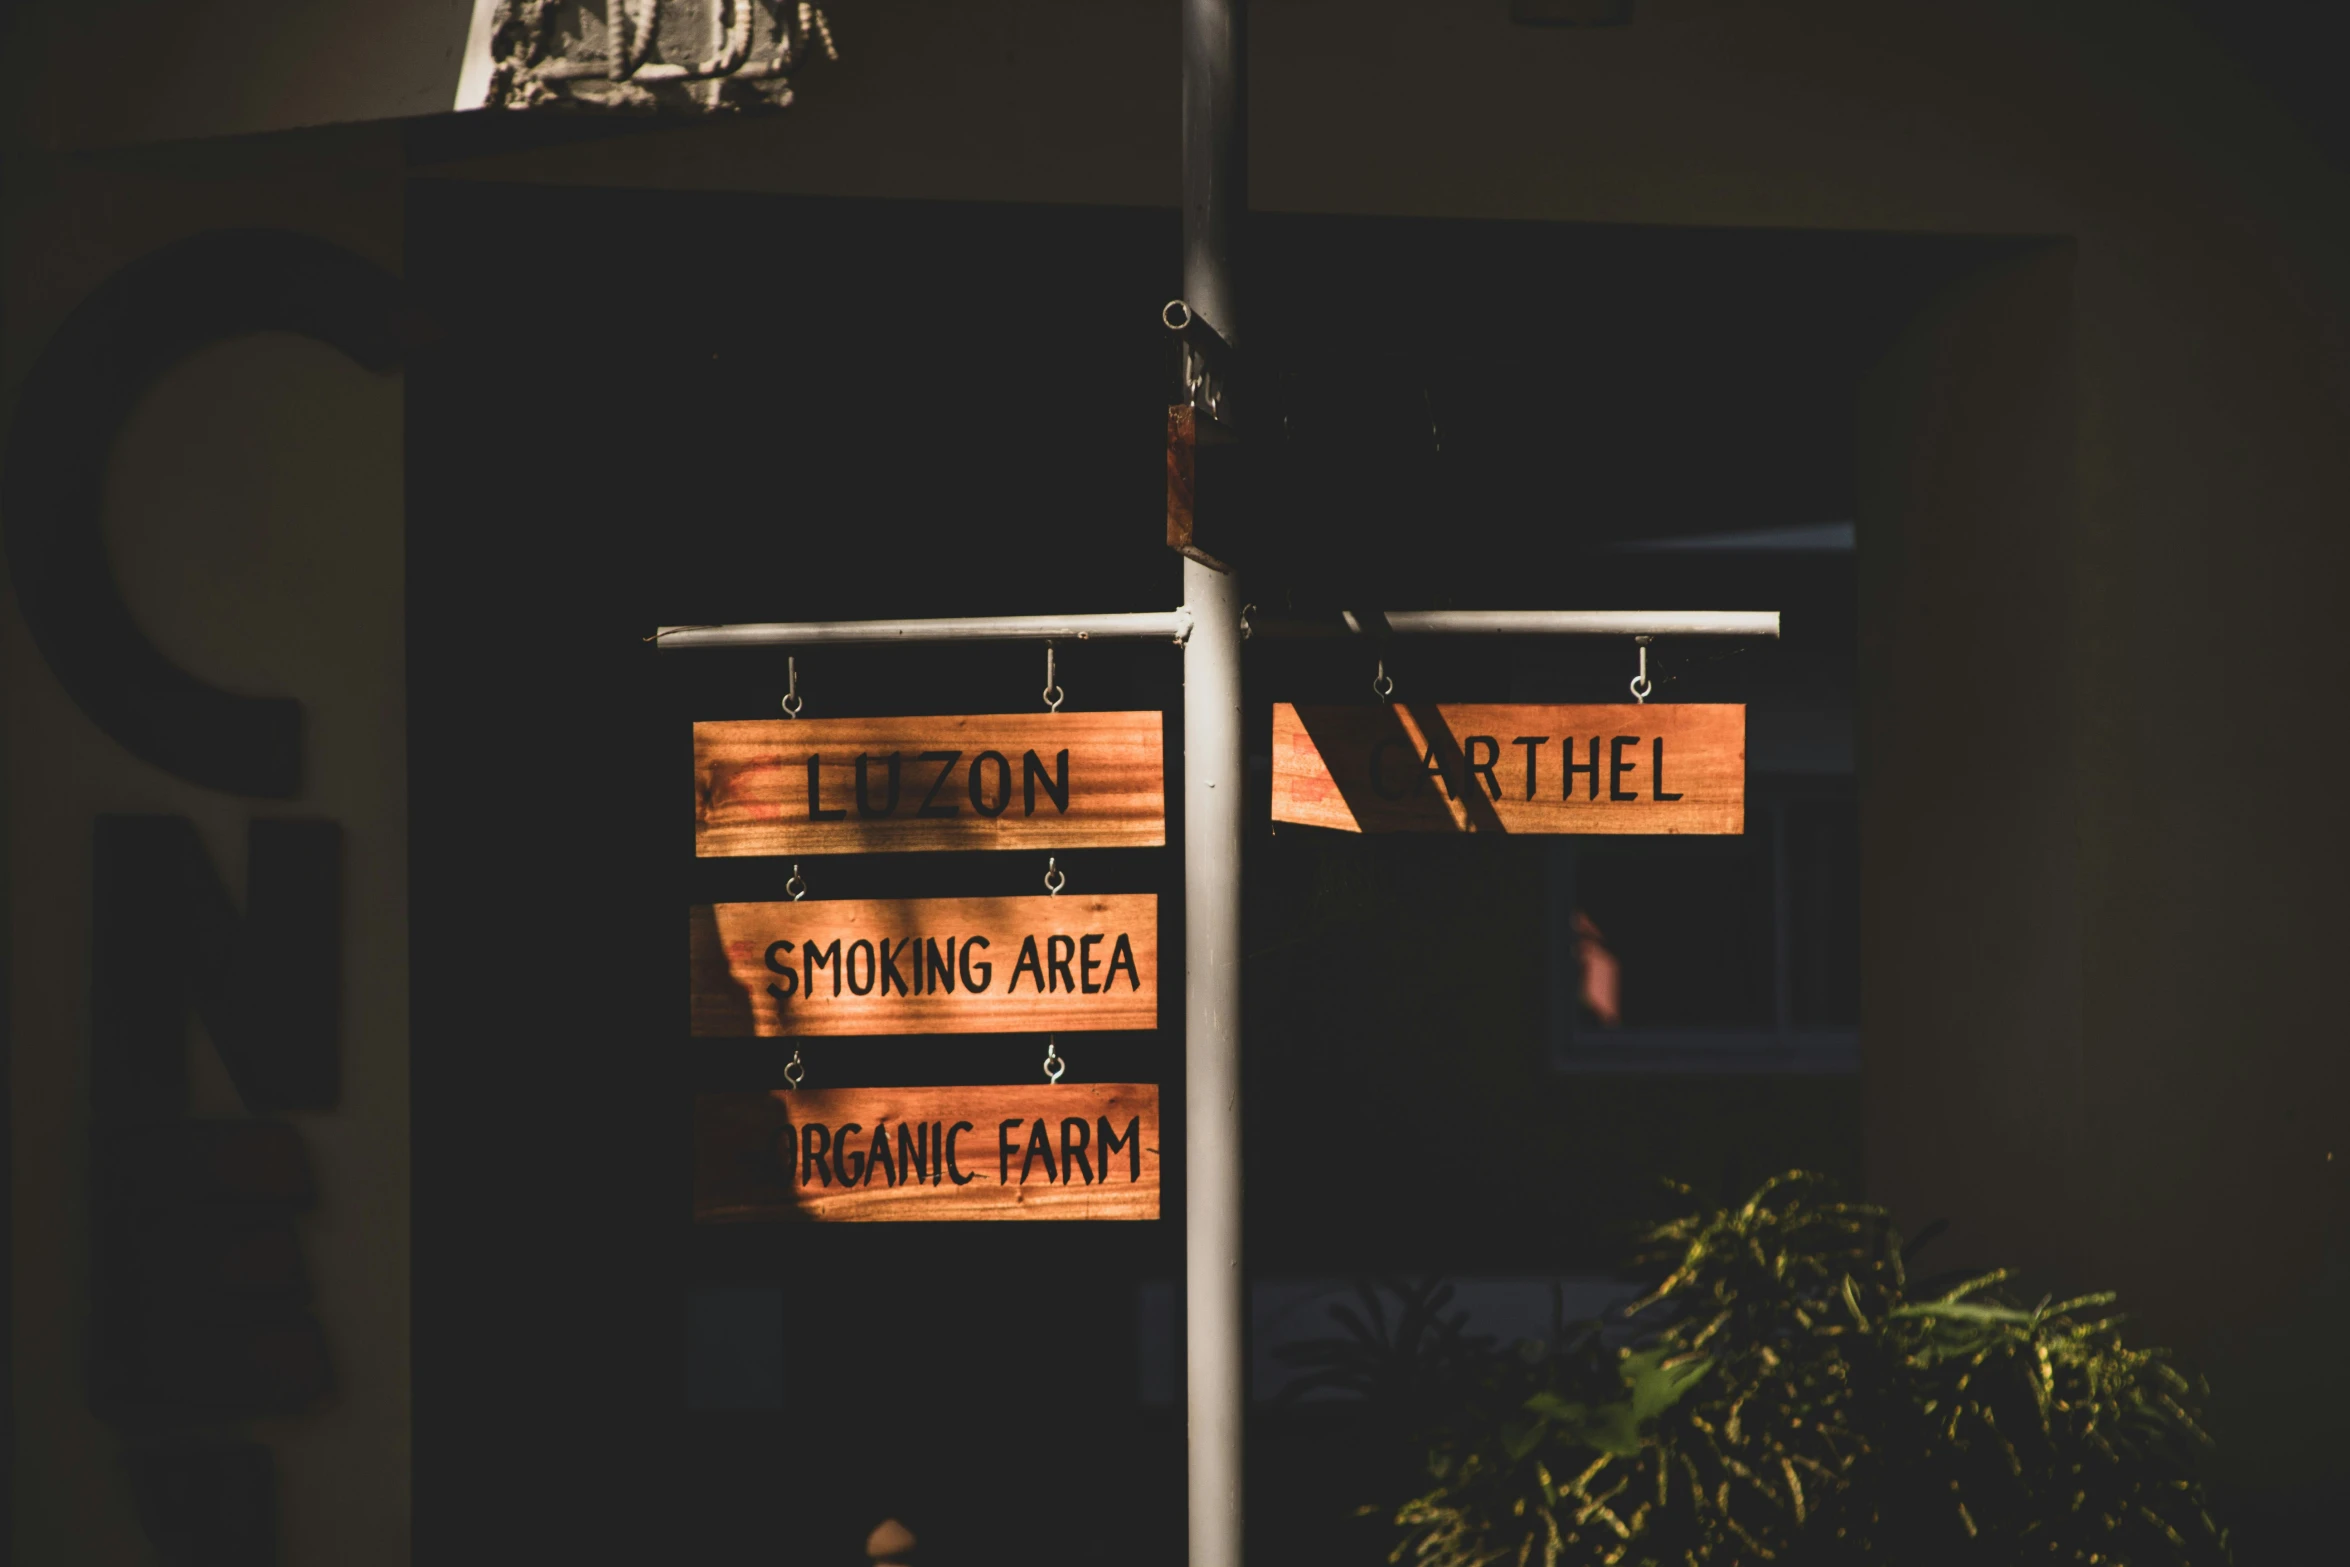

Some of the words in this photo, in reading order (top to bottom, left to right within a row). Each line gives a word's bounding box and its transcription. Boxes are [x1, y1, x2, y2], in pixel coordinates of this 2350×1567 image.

[807, 748, 1069, 822] LUZON
[1369, 736, 1684, 802] CARTHEL
[764, 936, 992, 999] SMOKING
[1008, 933, 1140, 995] AREA
[768, 1120, 974, 1188] ORGANIC
[1000, 1115, 1141, 1186] FARM
